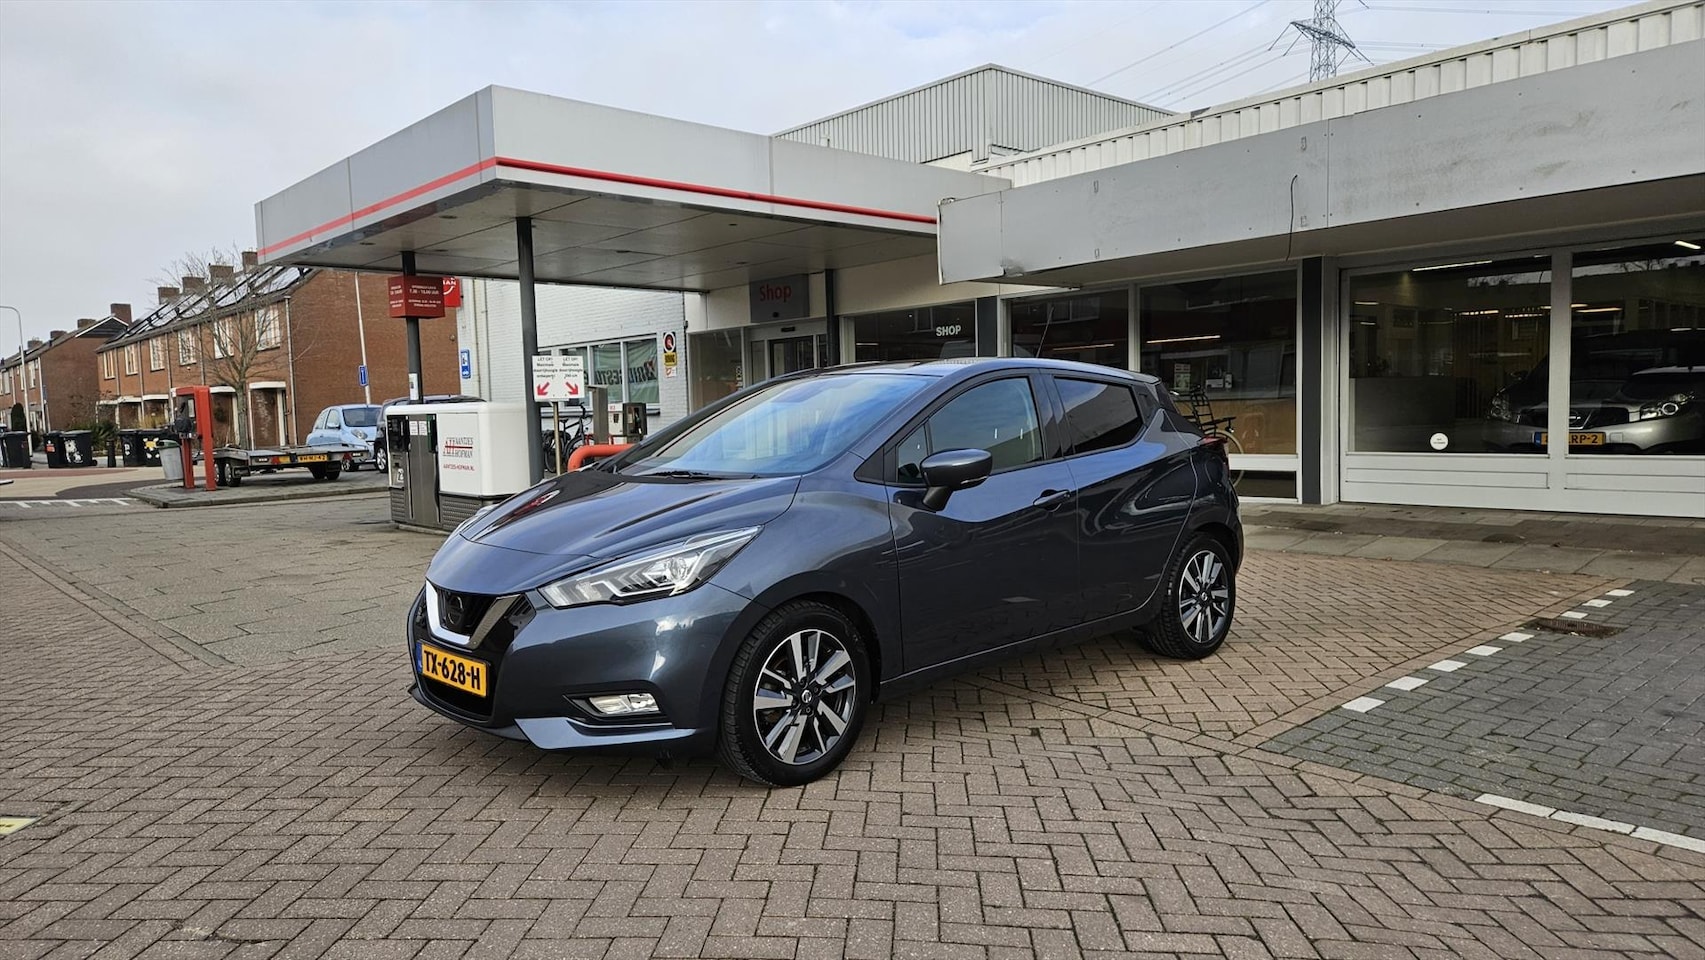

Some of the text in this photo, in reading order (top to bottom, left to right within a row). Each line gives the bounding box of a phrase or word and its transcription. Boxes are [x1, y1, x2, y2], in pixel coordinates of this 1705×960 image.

[760, 284, 792, 303] Shop
[936, 325, 961, 336] SHOP
[424, 650, 480, 690] TX-628-H
